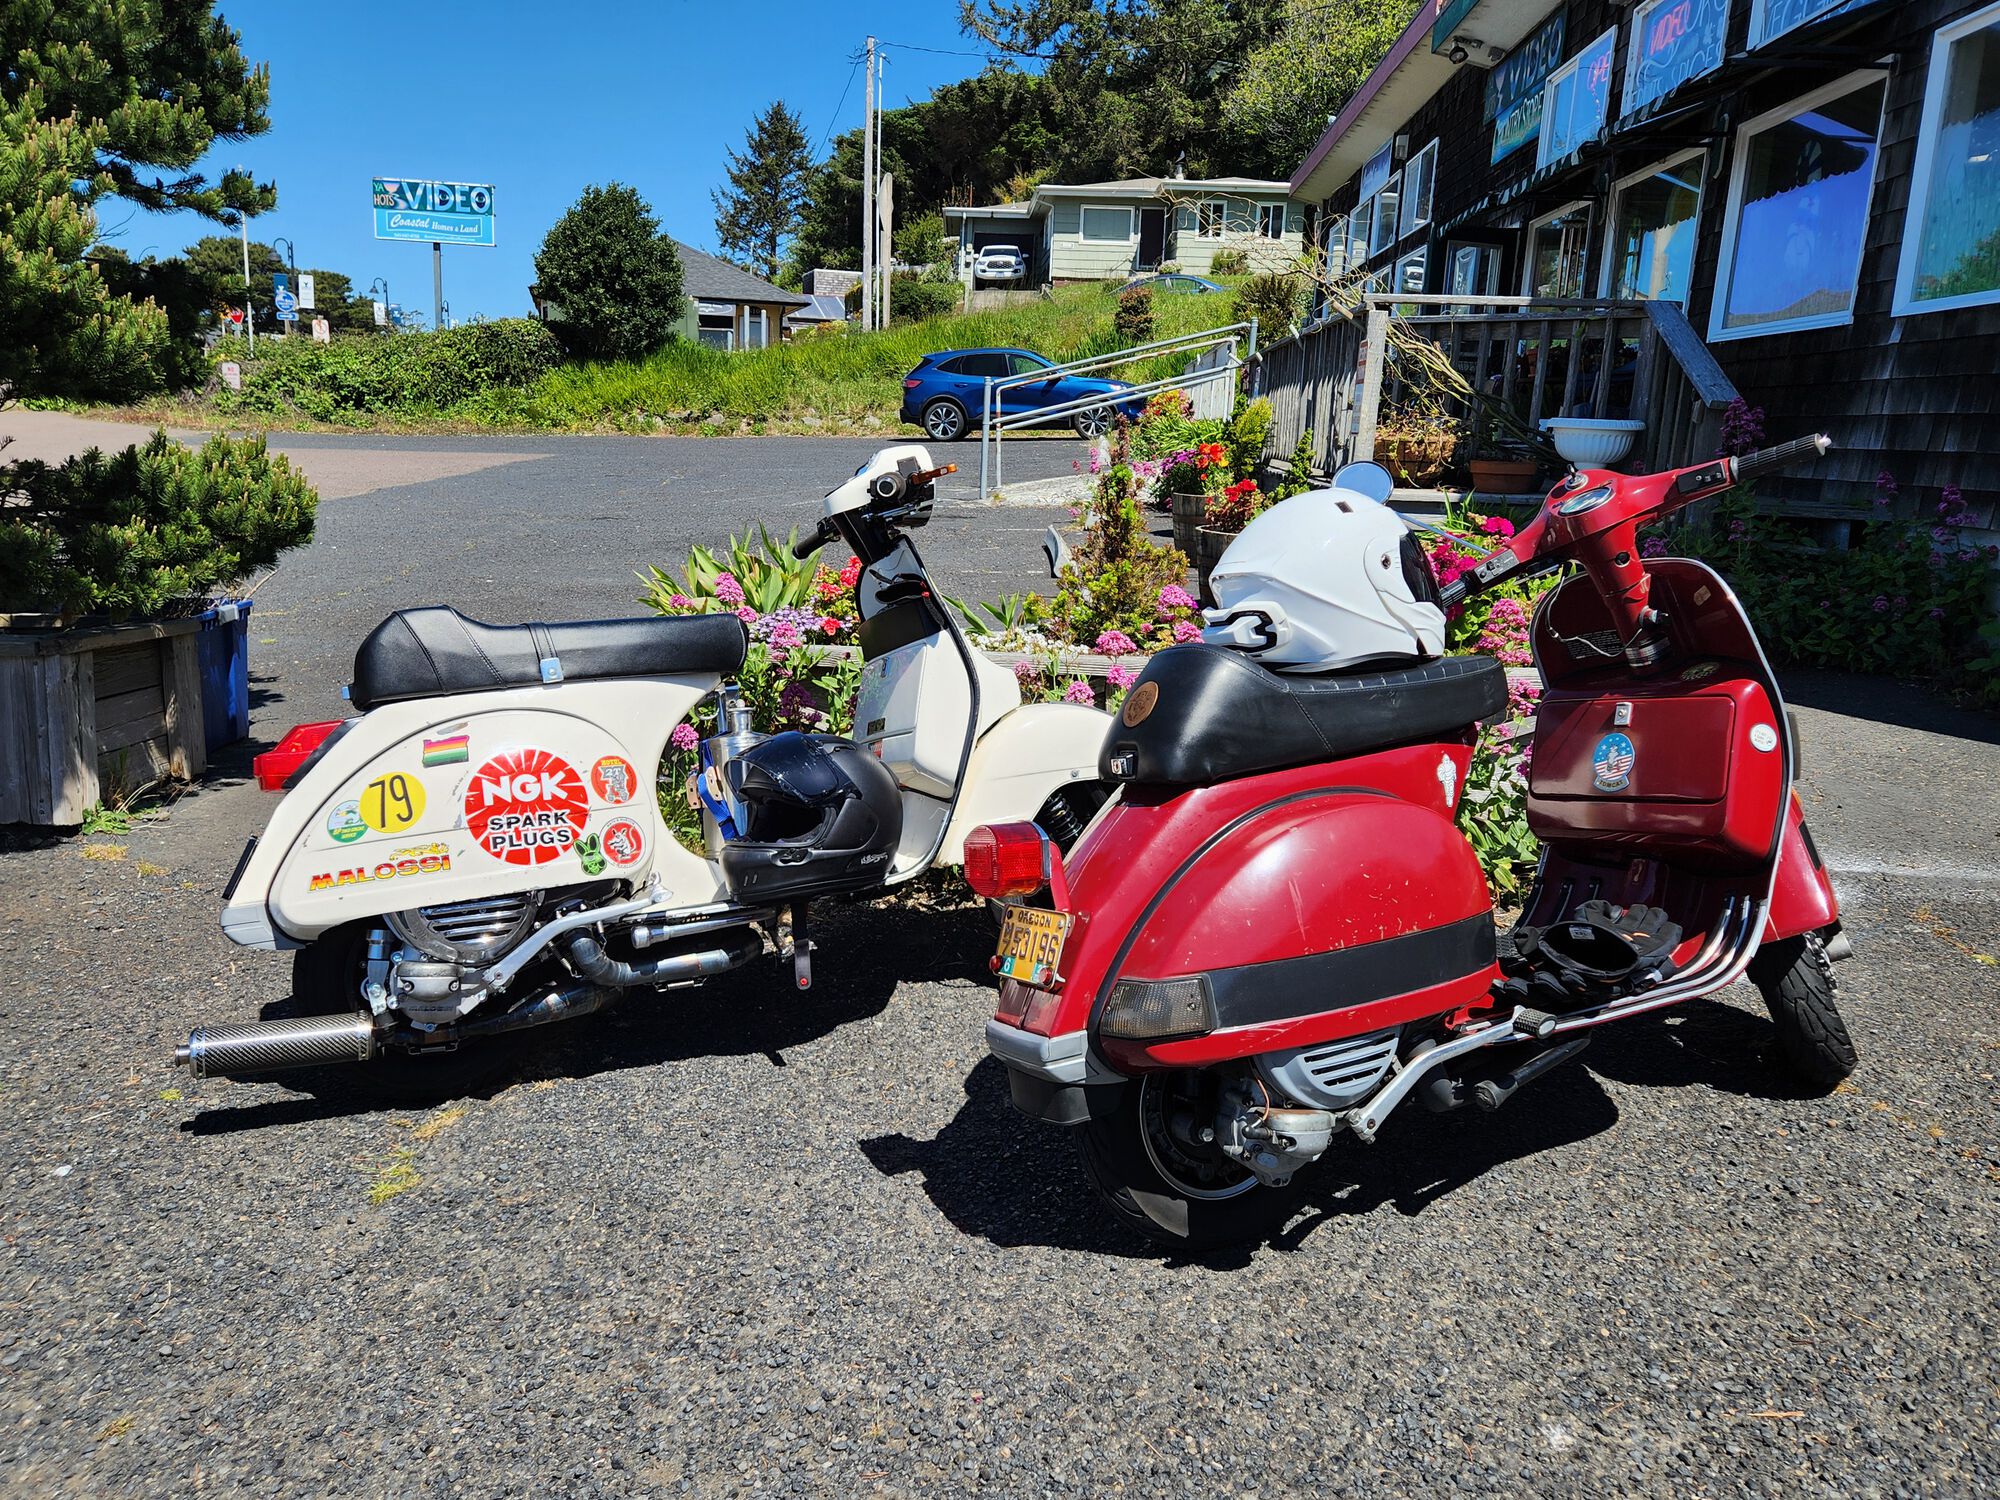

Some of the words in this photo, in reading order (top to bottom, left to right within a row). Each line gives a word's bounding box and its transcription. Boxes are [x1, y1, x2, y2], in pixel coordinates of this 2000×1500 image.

[1649, 0, 1691, 56] VIDEO
[1509, 18, 1562, 100] VIDEO
[373, 182, 385, 192] YA
[374, 194, 395, 207] HOTS
[401, 182, 491, 214] VIDEO
[390, 213, 430, 229] Coastal
[432, 221, 454, 232] Homes
[460, 224, 479, 233] Land
[368, 774, 413, 829] 79
[482, 771, 569, 806] NGK
[489, 811, 569, 832] SPARK
[491, 829, 571, 851] PLUGS
[309, 854, 451, 891] MALOSSI
[1018, 910, 1052, 928] OREGON
